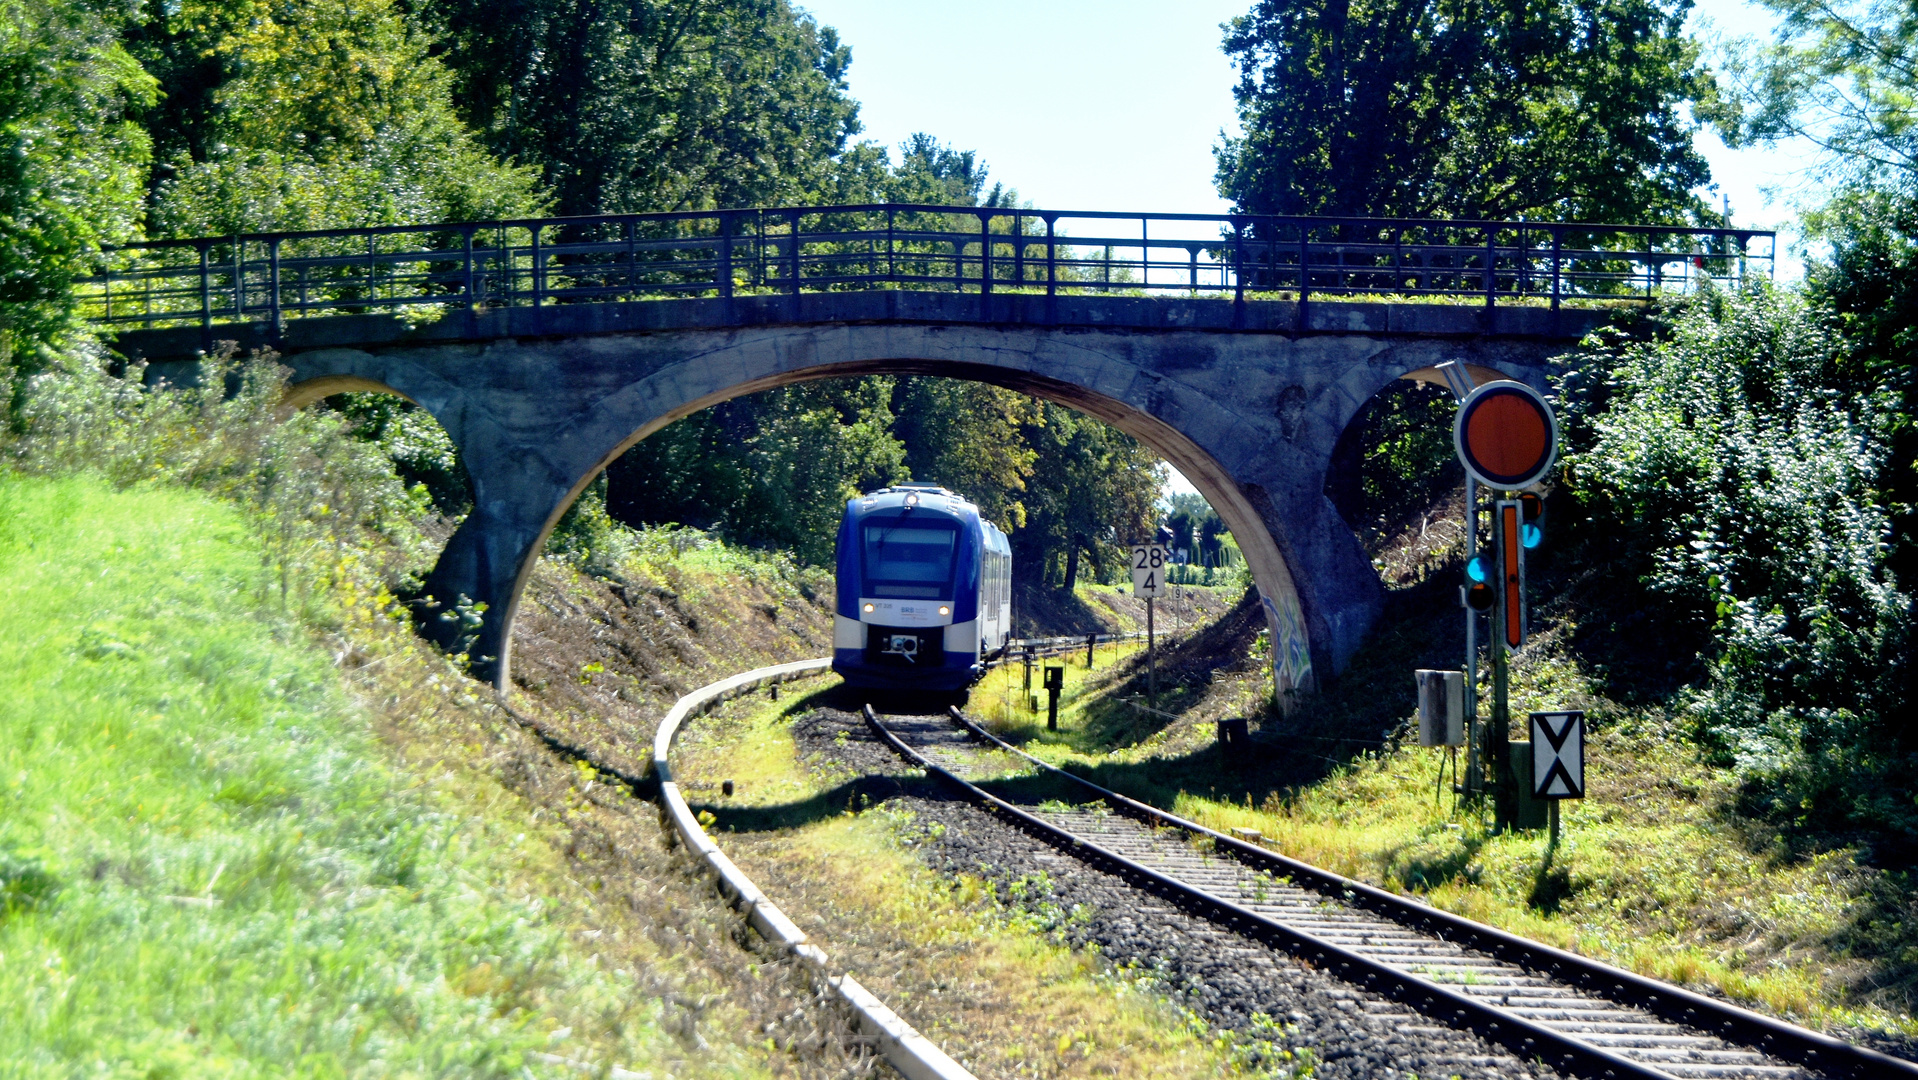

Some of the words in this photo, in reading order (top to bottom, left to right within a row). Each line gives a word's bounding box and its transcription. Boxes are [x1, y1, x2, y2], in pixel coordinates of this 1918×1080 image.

[1135, 548, 1162, 568] 28
[1143, 571, 1157, 592] 4
[1176, 589, 1180, 598] 9
